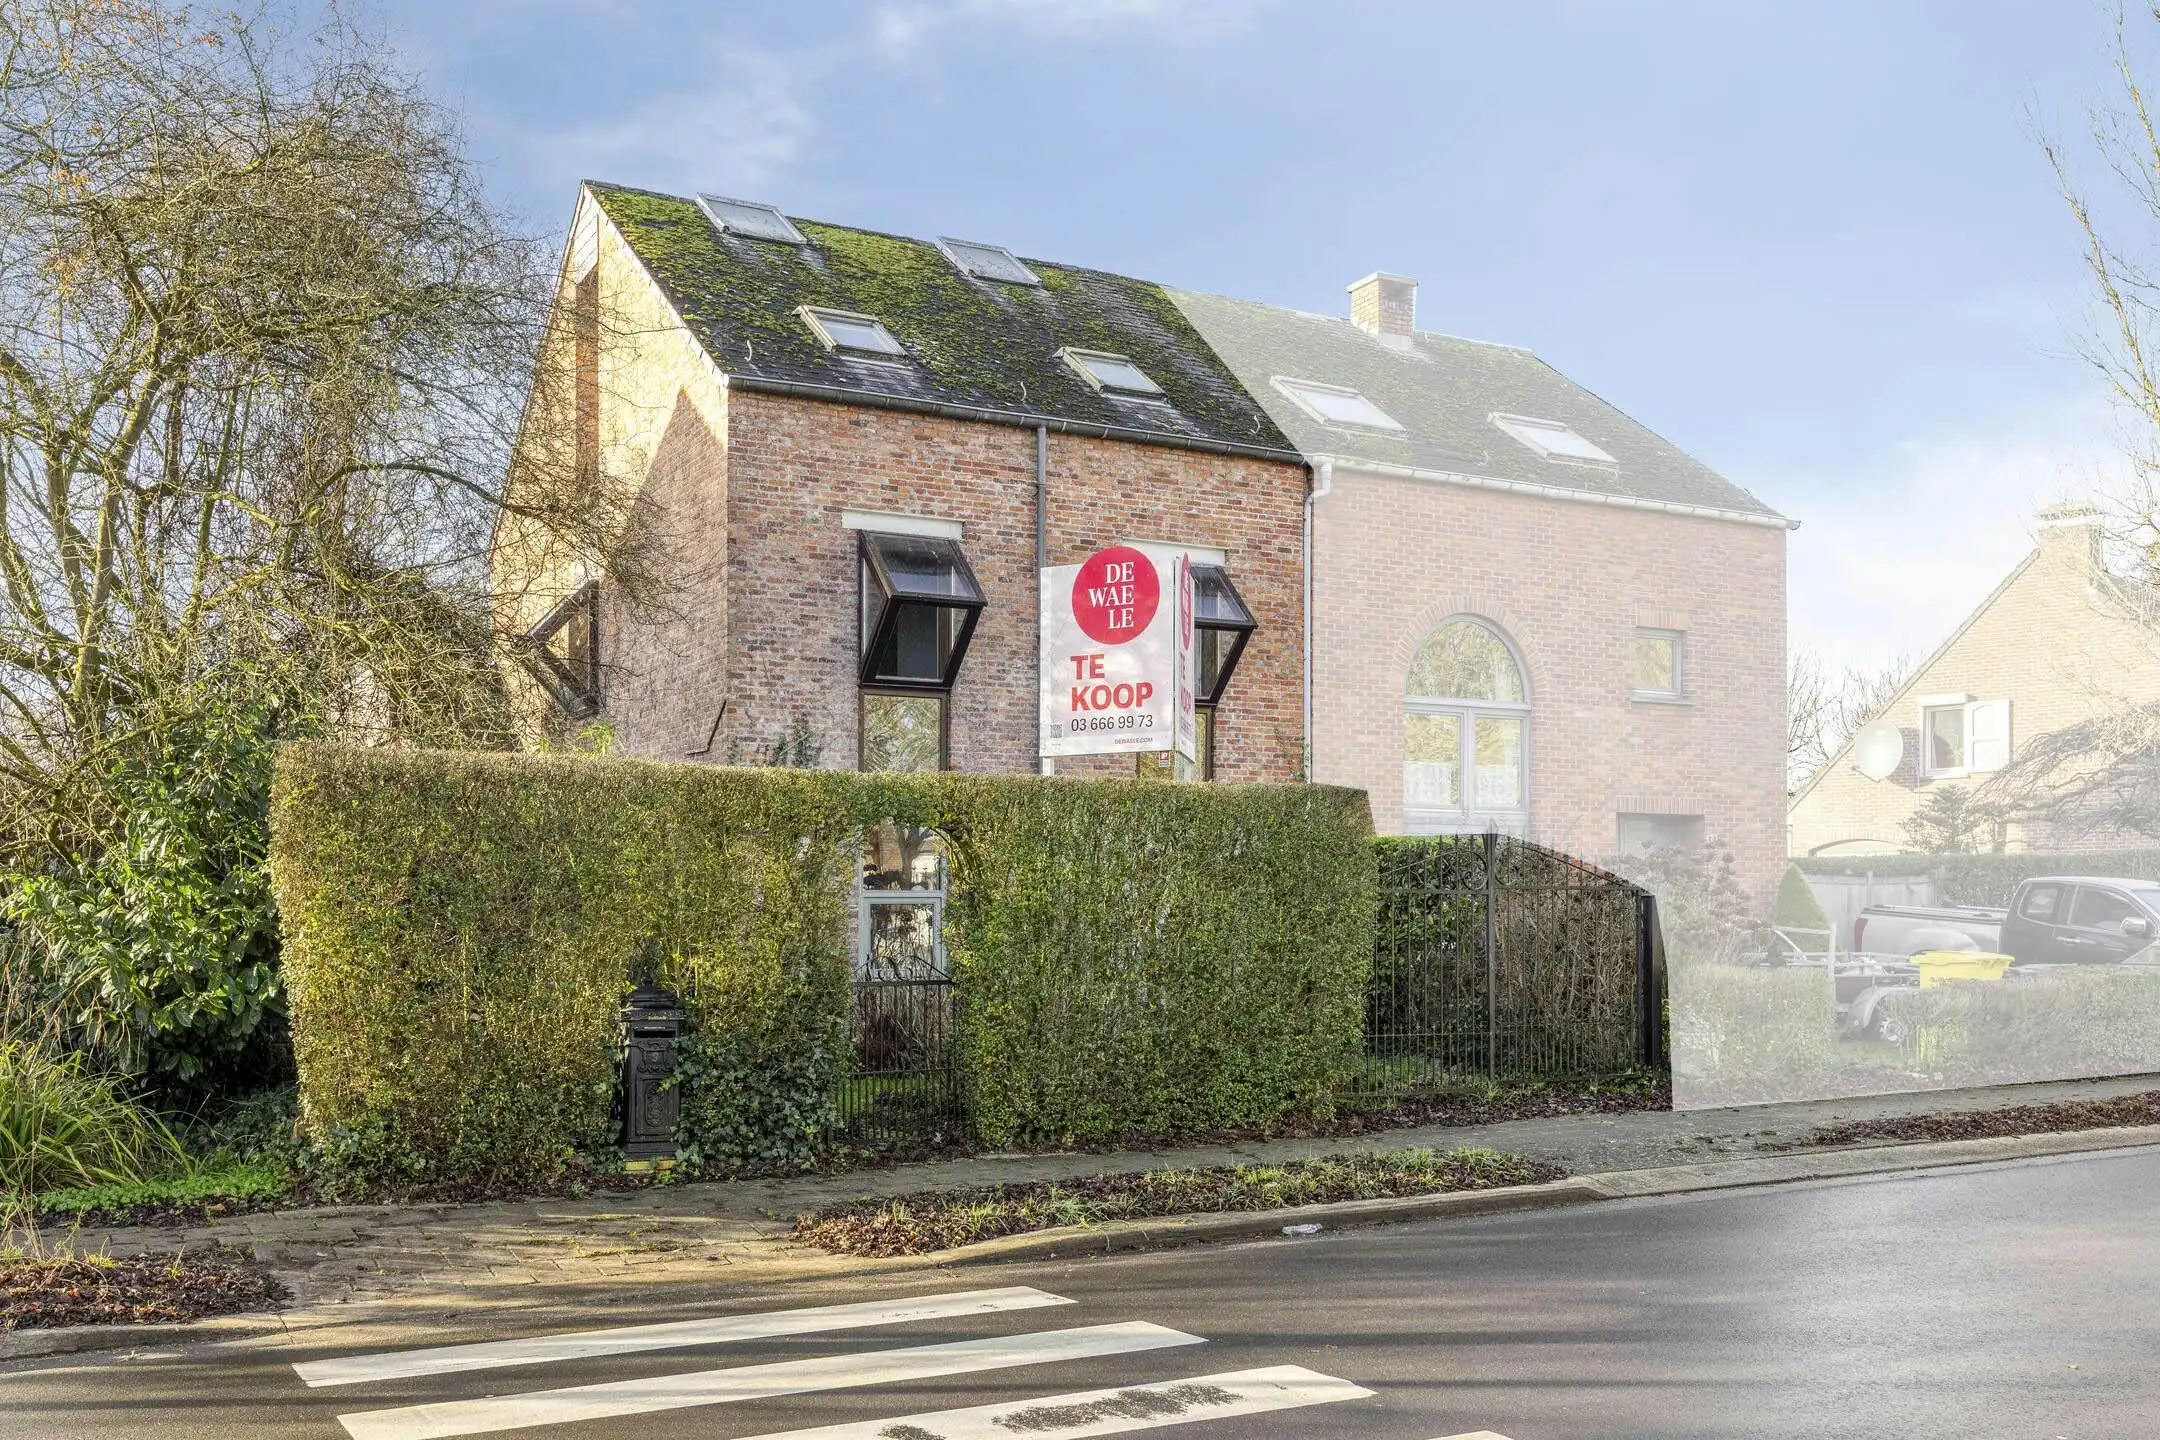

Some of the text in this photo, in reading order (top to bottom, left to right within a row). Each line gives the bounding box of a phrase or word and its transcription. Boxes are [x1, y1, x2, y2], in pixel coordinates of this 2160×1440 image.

[1105, 562, 1134, 584] DE
[1088, 585, 1134, 608] WAE
[1108, 608, 1134, 629] LE
[1070, 654, 1105, 680] TE
[1071, 682, 1153, 711] KOOP
[1071, 714, 1153, 732] 03 666 99 73
